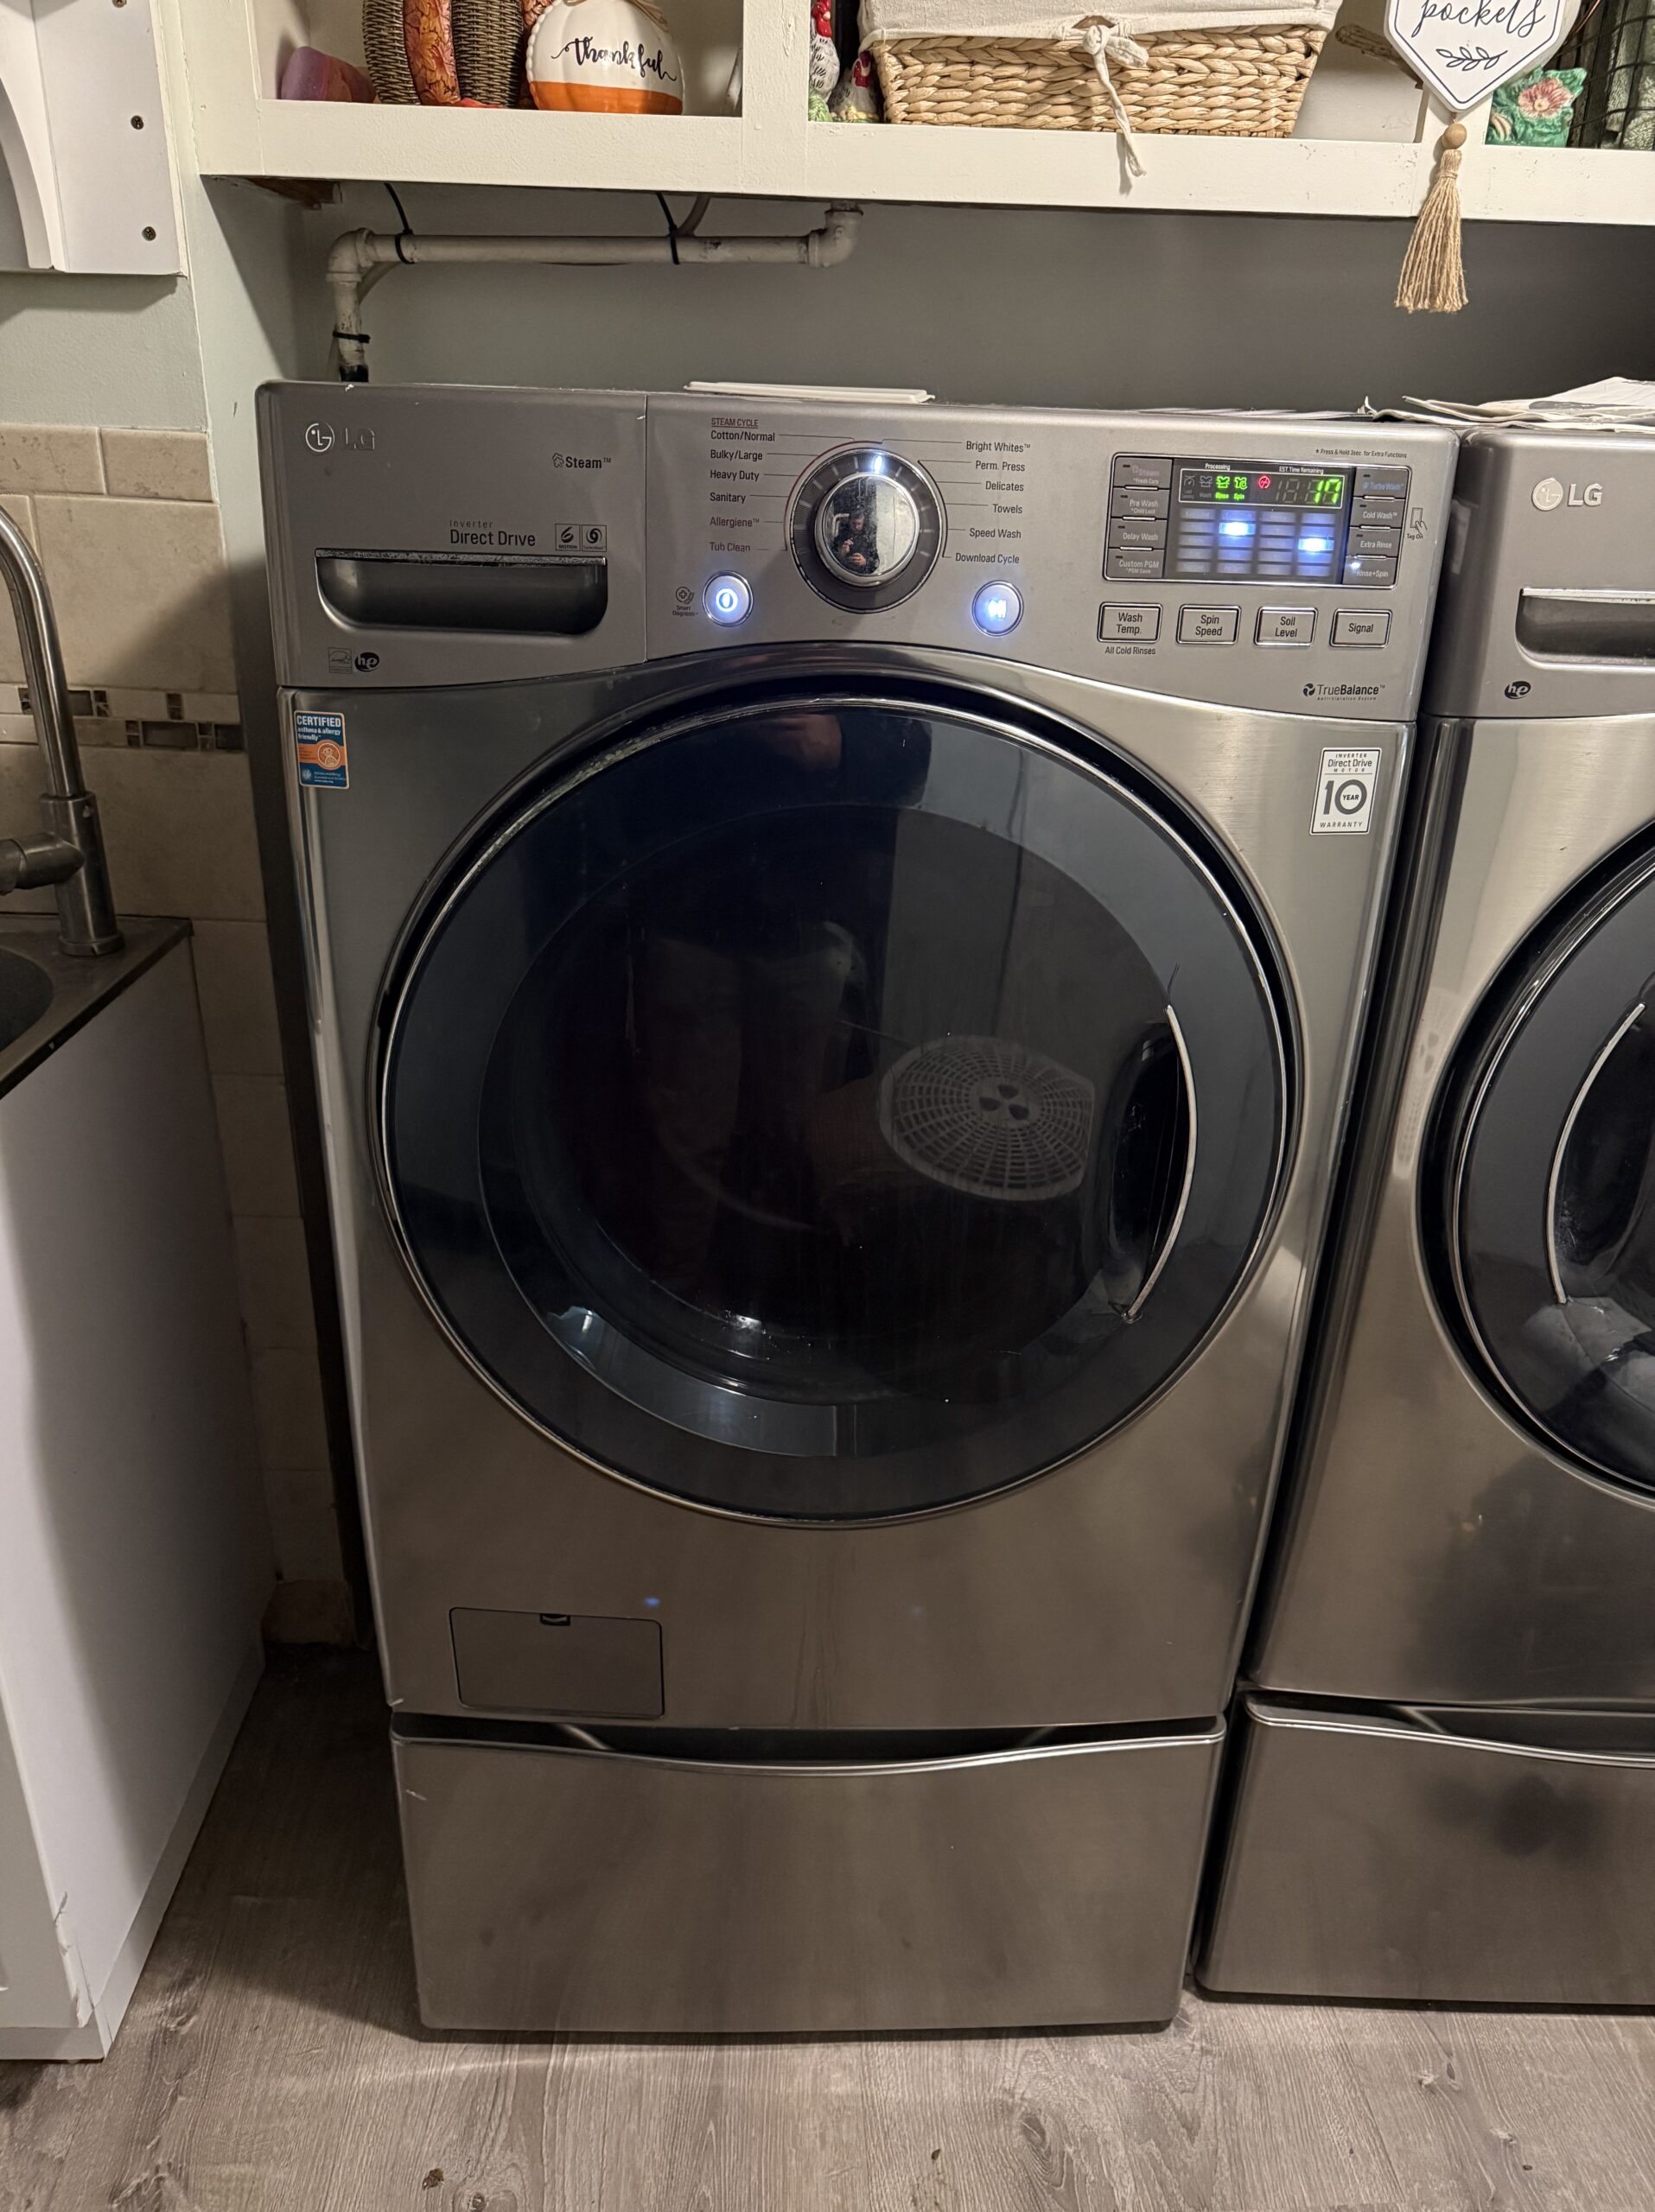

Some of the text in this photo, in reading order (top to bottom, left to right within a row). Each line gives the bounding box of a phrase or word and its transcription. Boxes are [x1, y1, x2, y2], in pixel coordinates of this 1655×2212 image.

[1410, 0, 1546, 38] pockets
[711, 417, 759, 428] STEAM CYCLE
[710, 430, 775, 442] Cotton/Normal
[966, 441, 992, 452] Bright
[710, 449, 763, 462] Bulky/Large
[1002, 461, 1026, 472] Press
[1205, 462, 1231, 472] Processing
[710, 470, 760, 482] Heavy Duty
[985, 480, 1024, 492] Delicates
[710, 493, 747, 504] Sanitary
[1568, 482, 1603, 506] LG
[992, 503, 1023, 514] Towels
[1130, 499, 1159, 508] Pre Wash
[449, 529, 536, 547] Direct Drive
[969, 528, 1022, 539] Speed Wash
[1123, 531, 1158, 541] Delay Wash
[710, 542, 751, 552] Tub Clean
[955, 553, 1020, 565] Download Cycle
[1118, 613, 1143, 623] Wash
[1200, 614, 1219, 626] Spin
[1280, 616, 1295, 626] Soil
[1116, 624, 1142, 635] Temp.
[1195, 626, 1223, 637] Speed
[1275, 627, 1297, 638] Level
[1348, 622, 1374, 635] Signal
[1104, 646, 1156, 656] All Cold Rinses
[296, 715, 341, 728] CERTIFIED
[321, 728, 341, 736] allergy
[1327, 759, 1372, 767] Direct Drive
[1323, 779, 1368, 816] 10
